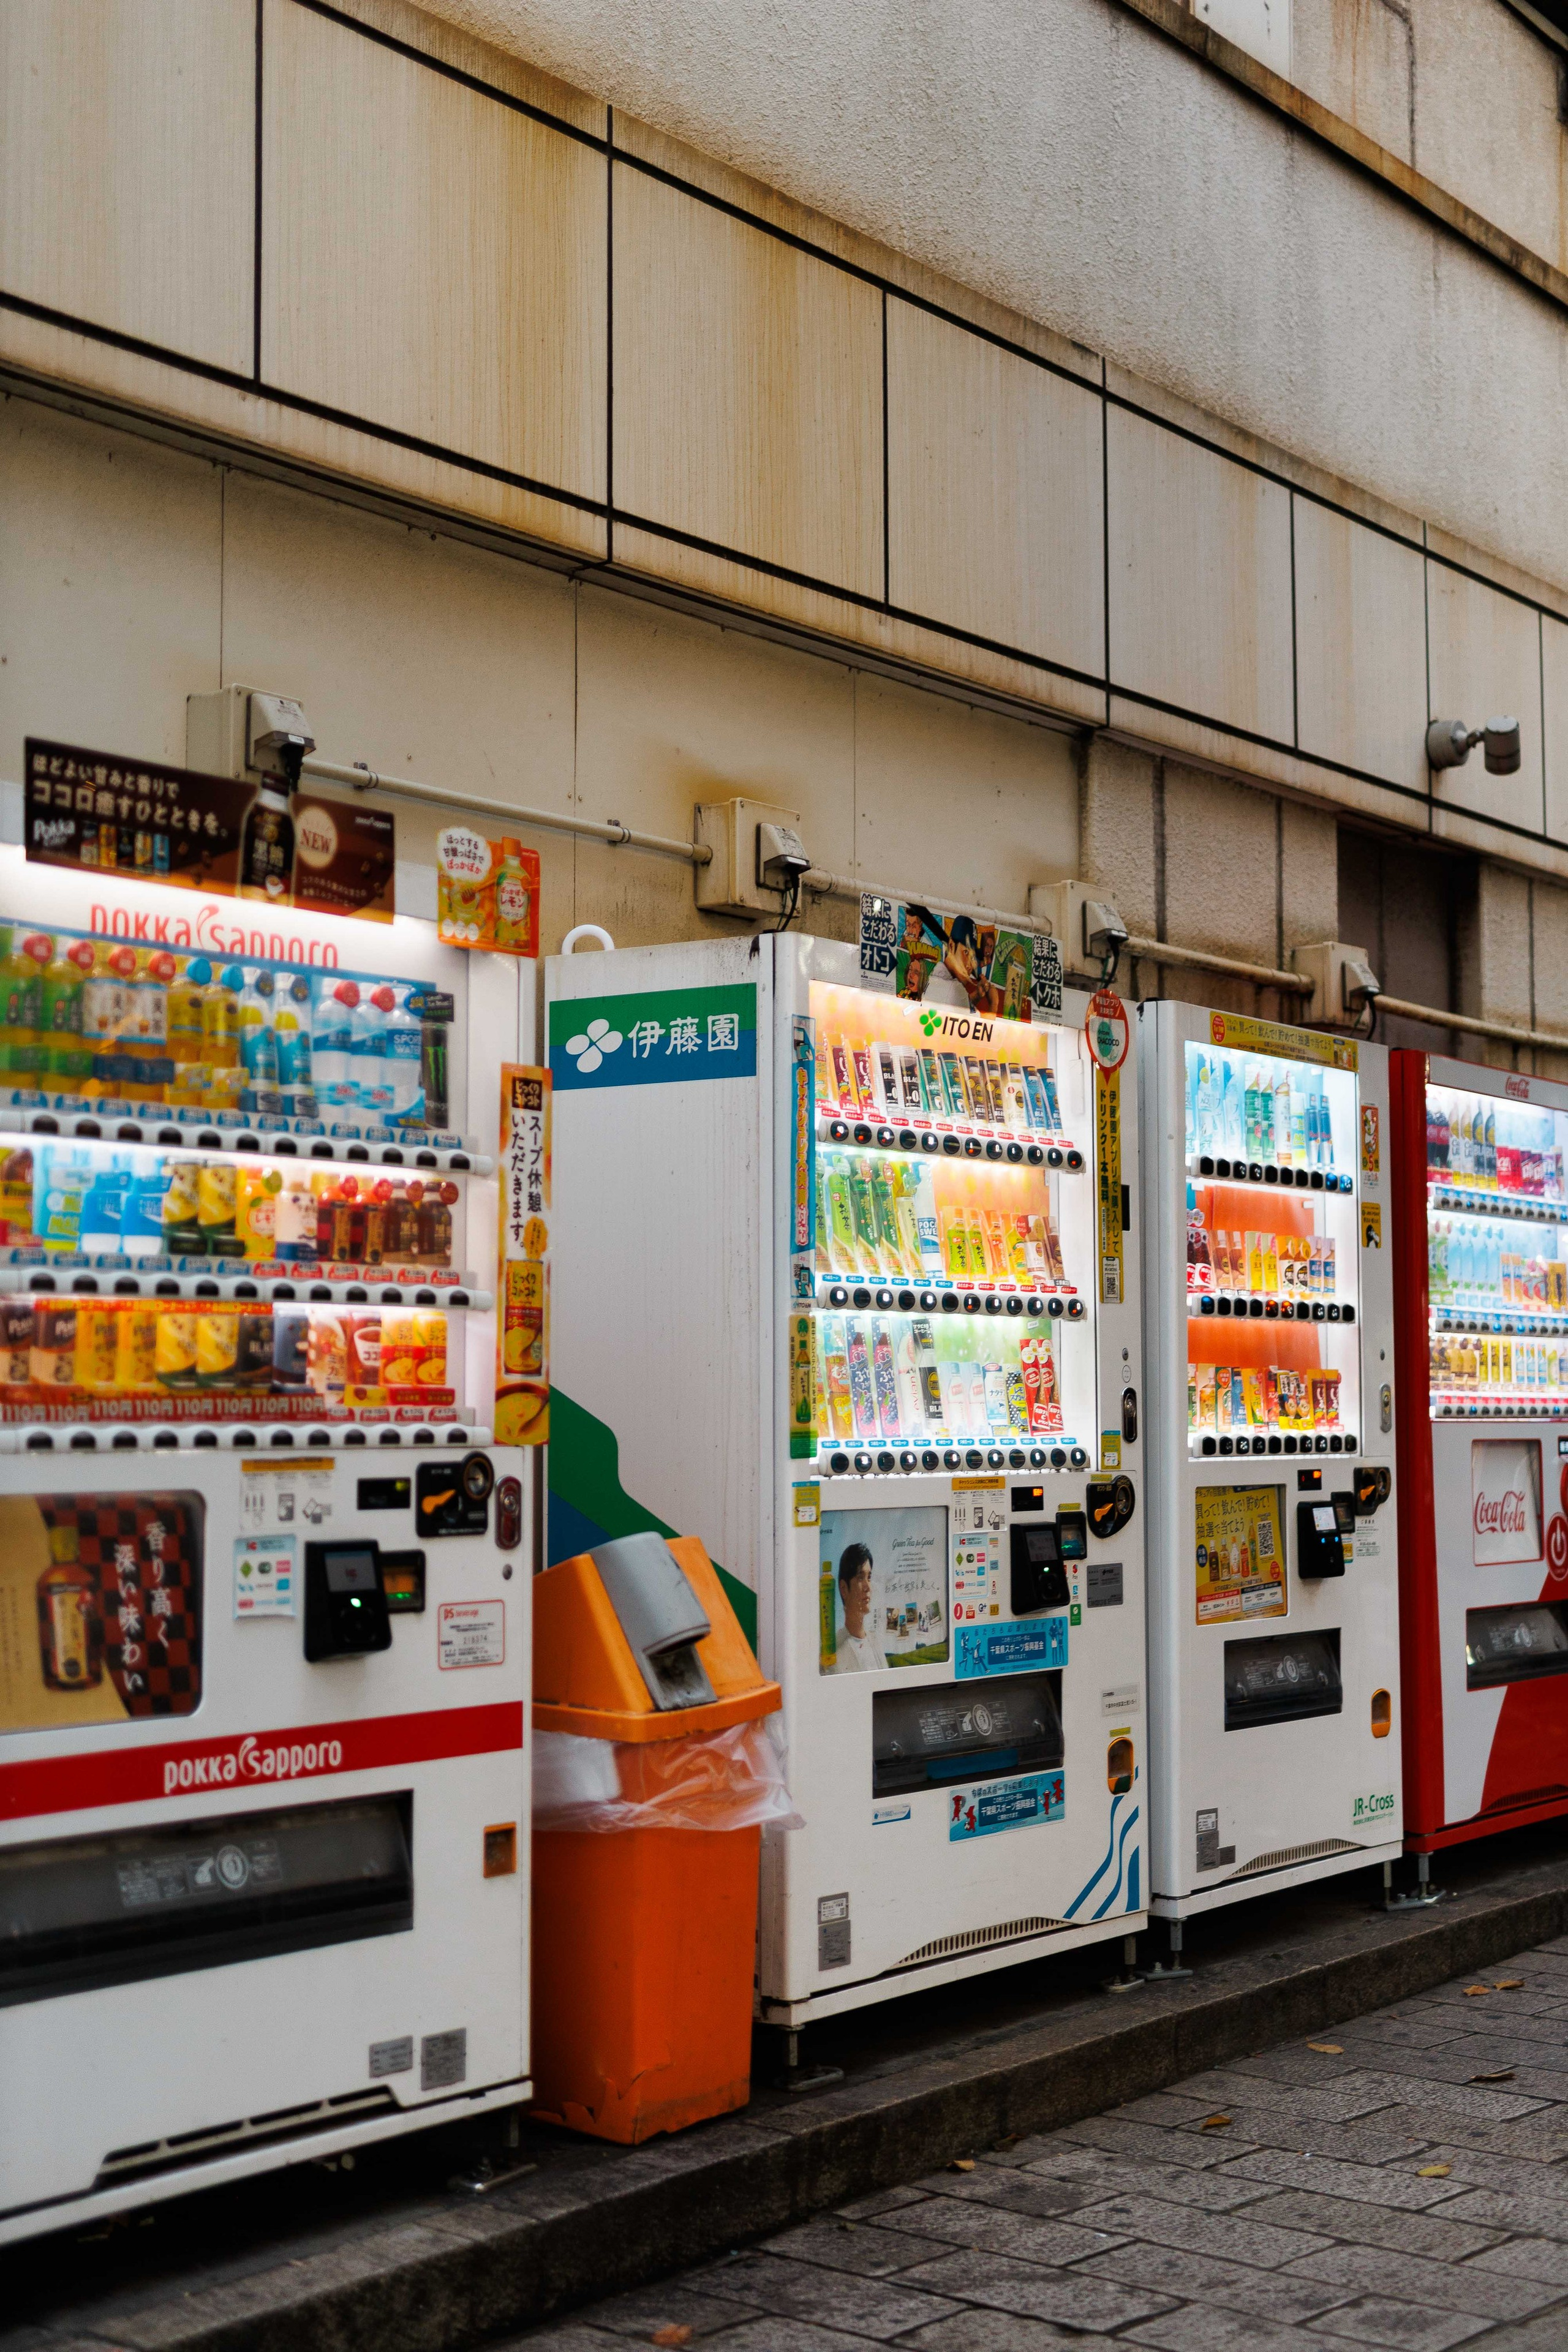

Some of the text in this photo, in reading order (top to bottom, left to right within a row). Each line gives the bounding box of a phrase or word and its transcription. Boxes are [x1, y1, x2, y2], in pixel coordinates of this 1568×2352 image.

[300, 827, 332, 854] NEW
[500, 894, 525, 908] レモン
[862, 919, 895, 943] こだわる
[862, 945, 890, 972] オトコ
[1033, 937, 1057, 958] 結果に
[1033, 959, 1061, 981] こだわる
[1036, 982, 1060, 1008] トクホ
[627, 1013, 739, 1058] 伊藤園
[942, 1016, 993, 1042] ITO EN
[527, 1115, 542, 1213] スープ休憩
[510, 1114, 526, 1248] いただきます。
[892, 1538, 906, 1551] Green
[907, 1536, 916, 1547] Tea
[921, 1536, 935, 1549] Good
[145, 1520, 174, 1648] 香り高く
[114, 1543, 145, 1693] 深い味わい
[990, 1641, 1045, 1655] 千葉県スポーツ振興基金
[1353, 1794, 1395, 1817] JR-Cross
